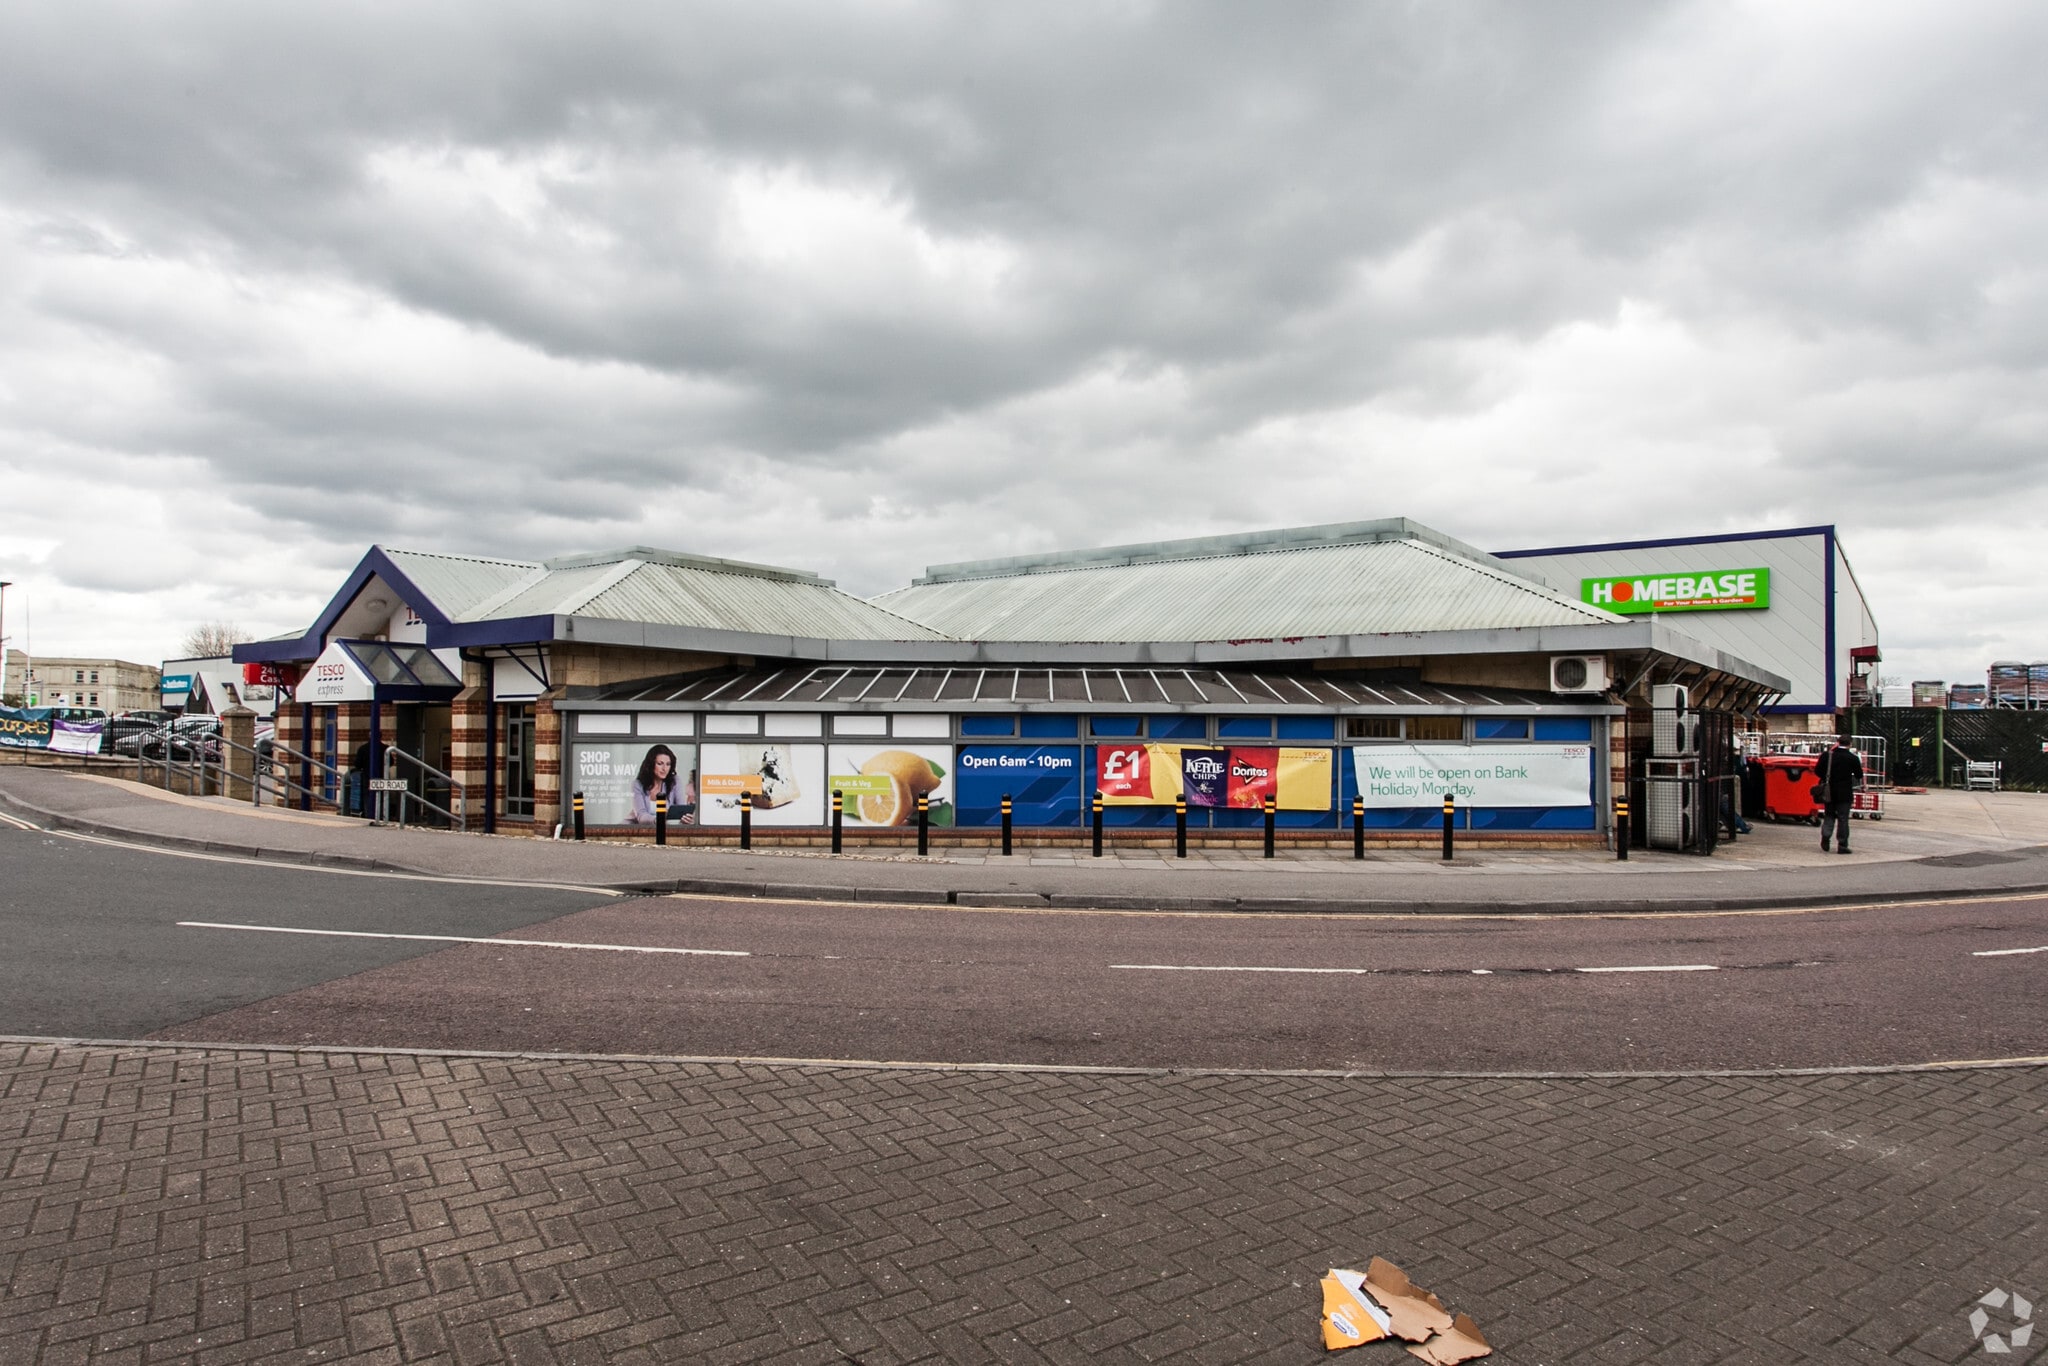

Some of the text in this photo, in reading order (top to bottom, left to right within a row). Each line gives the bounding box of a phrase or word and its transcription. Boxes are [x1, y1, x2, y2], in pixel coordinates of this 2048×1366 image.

[1592, 573, 1756, 604] HOMEBASE
[317, 663, 345, 676] TESCO
[317, 684, 344, 698] express
[580, 751, 611, 763] SHOP
[963, 754, 997, 768] Open
[999, 755, 1027, 767] 6am
[1037, 755, 1072, 769] 10pm
[580, 763, 637, 776] YOUR WAY
[1103, 750, 1140, 779] £1
[1185, 757, 1225, 774] KETTLE
[1232, 766, 1268, 777] Doritos
[1369, 766, 1528, 781] We will be open on Bank
[371, 781, 406, 789] OLD ROAD
[727, 779, 744, 787] Dairy
[858, 780, 872, 789] Veg
[1370, 782, 1476, 798] Holiday Monday.
